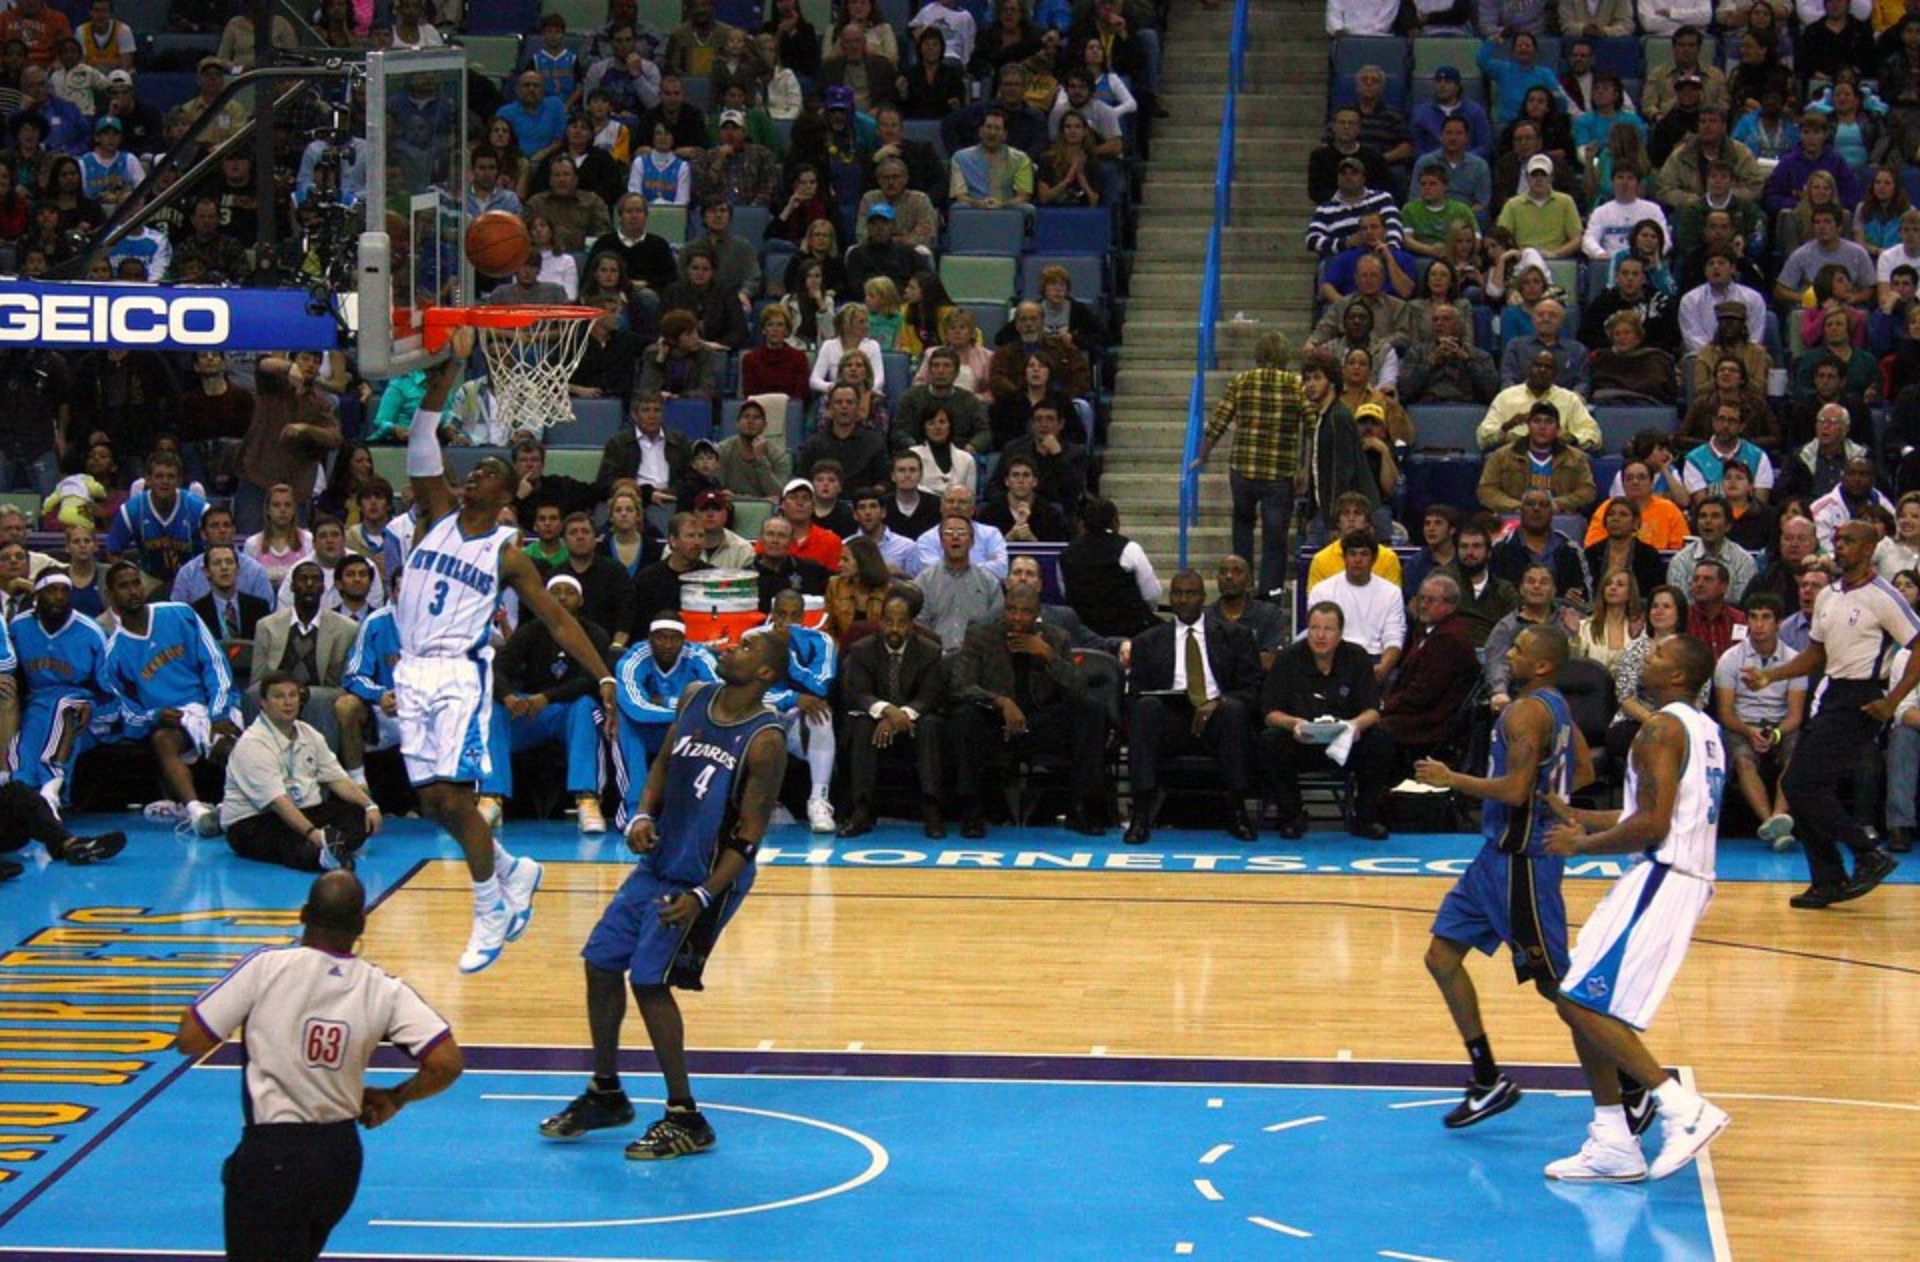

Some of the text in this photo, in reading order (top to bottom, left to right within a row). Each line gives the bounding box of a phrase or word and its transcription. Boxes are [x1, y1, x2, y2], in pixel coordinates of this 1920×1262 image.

[0, 293, 230, 345] GEICO
[407, 548, 495, 596] NEW ORLEANS
[428, 580, 449, 616] 3
[693, 764, 717, 800] 4
[307, 1024, 342, 1063] 63
